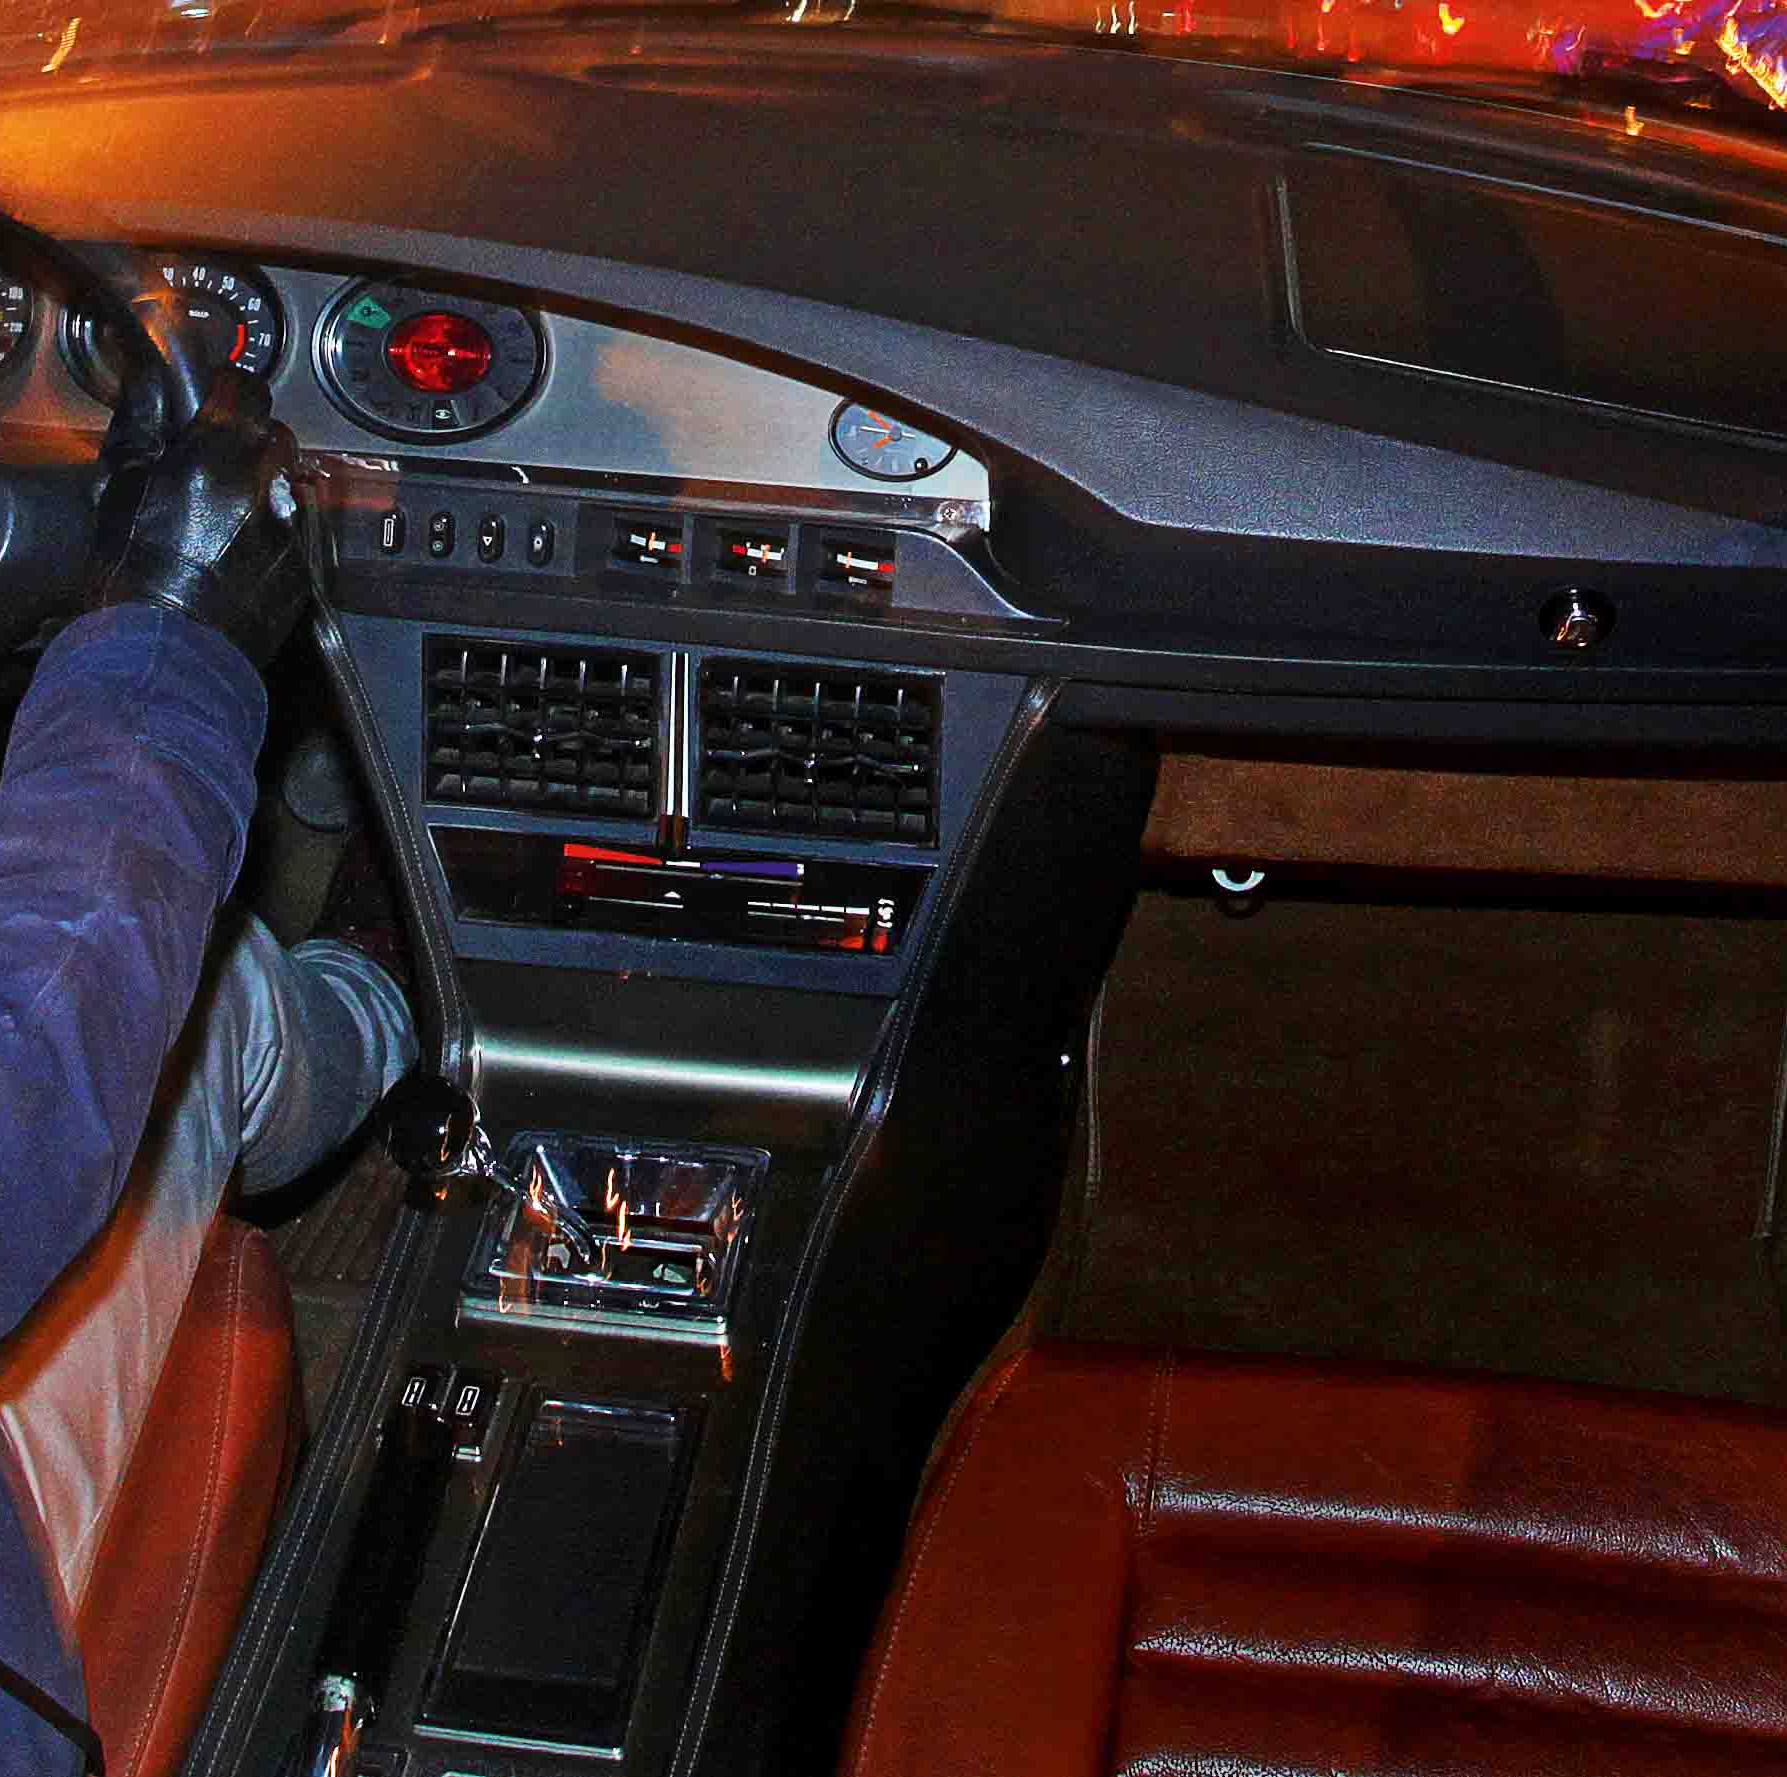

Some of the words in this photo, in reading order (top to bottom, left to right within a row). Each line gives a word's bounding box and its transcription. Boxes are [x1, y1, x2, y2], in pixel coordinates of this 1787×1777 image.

[192, 267, 206, 281] 40
[222, 276, 235, 290] 50
[258, 332, 271, 347] 70
